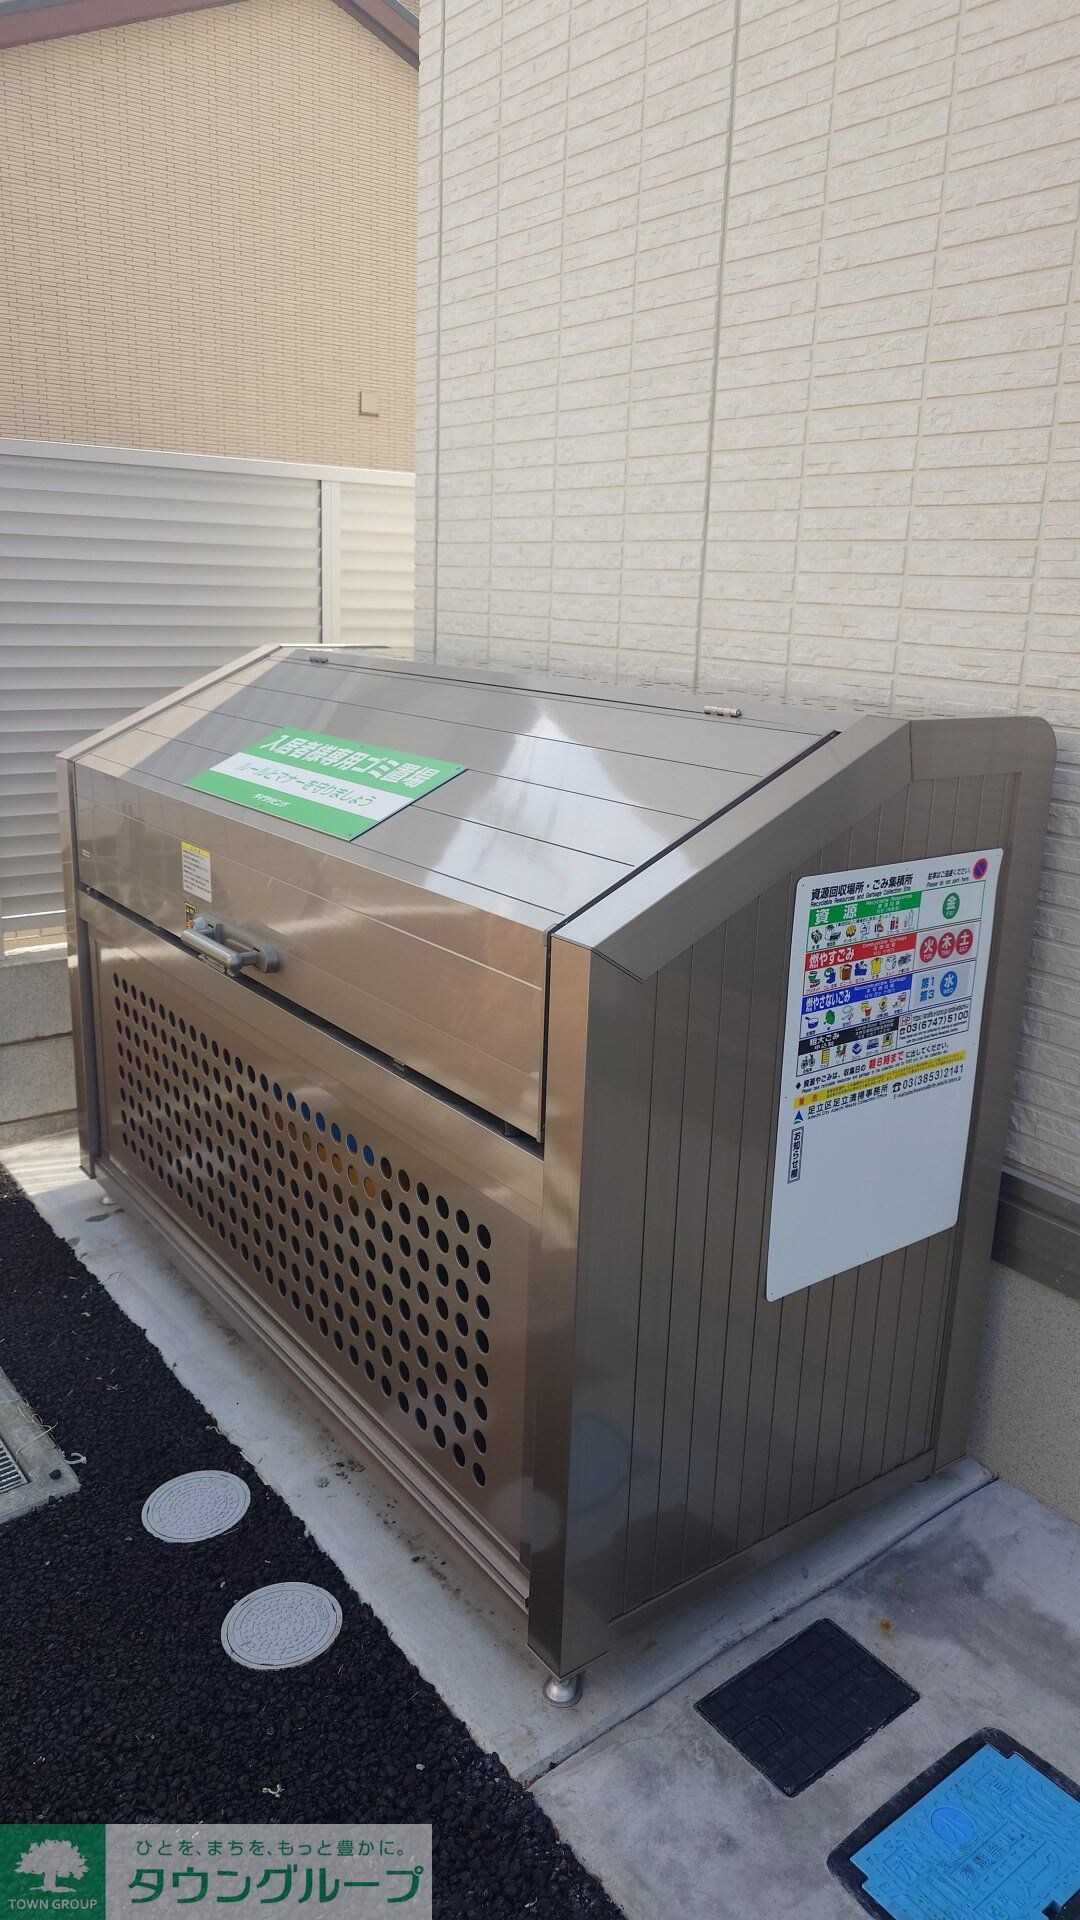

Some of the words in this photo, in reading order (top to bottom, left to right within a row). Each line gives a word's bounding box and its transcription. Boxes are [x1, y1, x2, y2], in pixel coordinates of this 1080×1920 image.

[260, 734, 441, 789] 入居者様専用ゴミ置場
[236, 761, 377, 807] ルールとマナーを守りましょう
[811, 873, 913, 901] 資源回収場所・ごみ集積所
[923, 938, 934, 954] 火
[942, 935, 953, 949] 木
[959, 932, 970, 946] 土
[808, 946, 855, 969] 燃やすごみ
[944, 973, 955, 988] 水
[805, 989, 852, 1013] 燃やさないごみ
[809, 1032, 840, 1047] 粗大ごみ
[902, 1064, 964, 1090] 03(3853)2141
